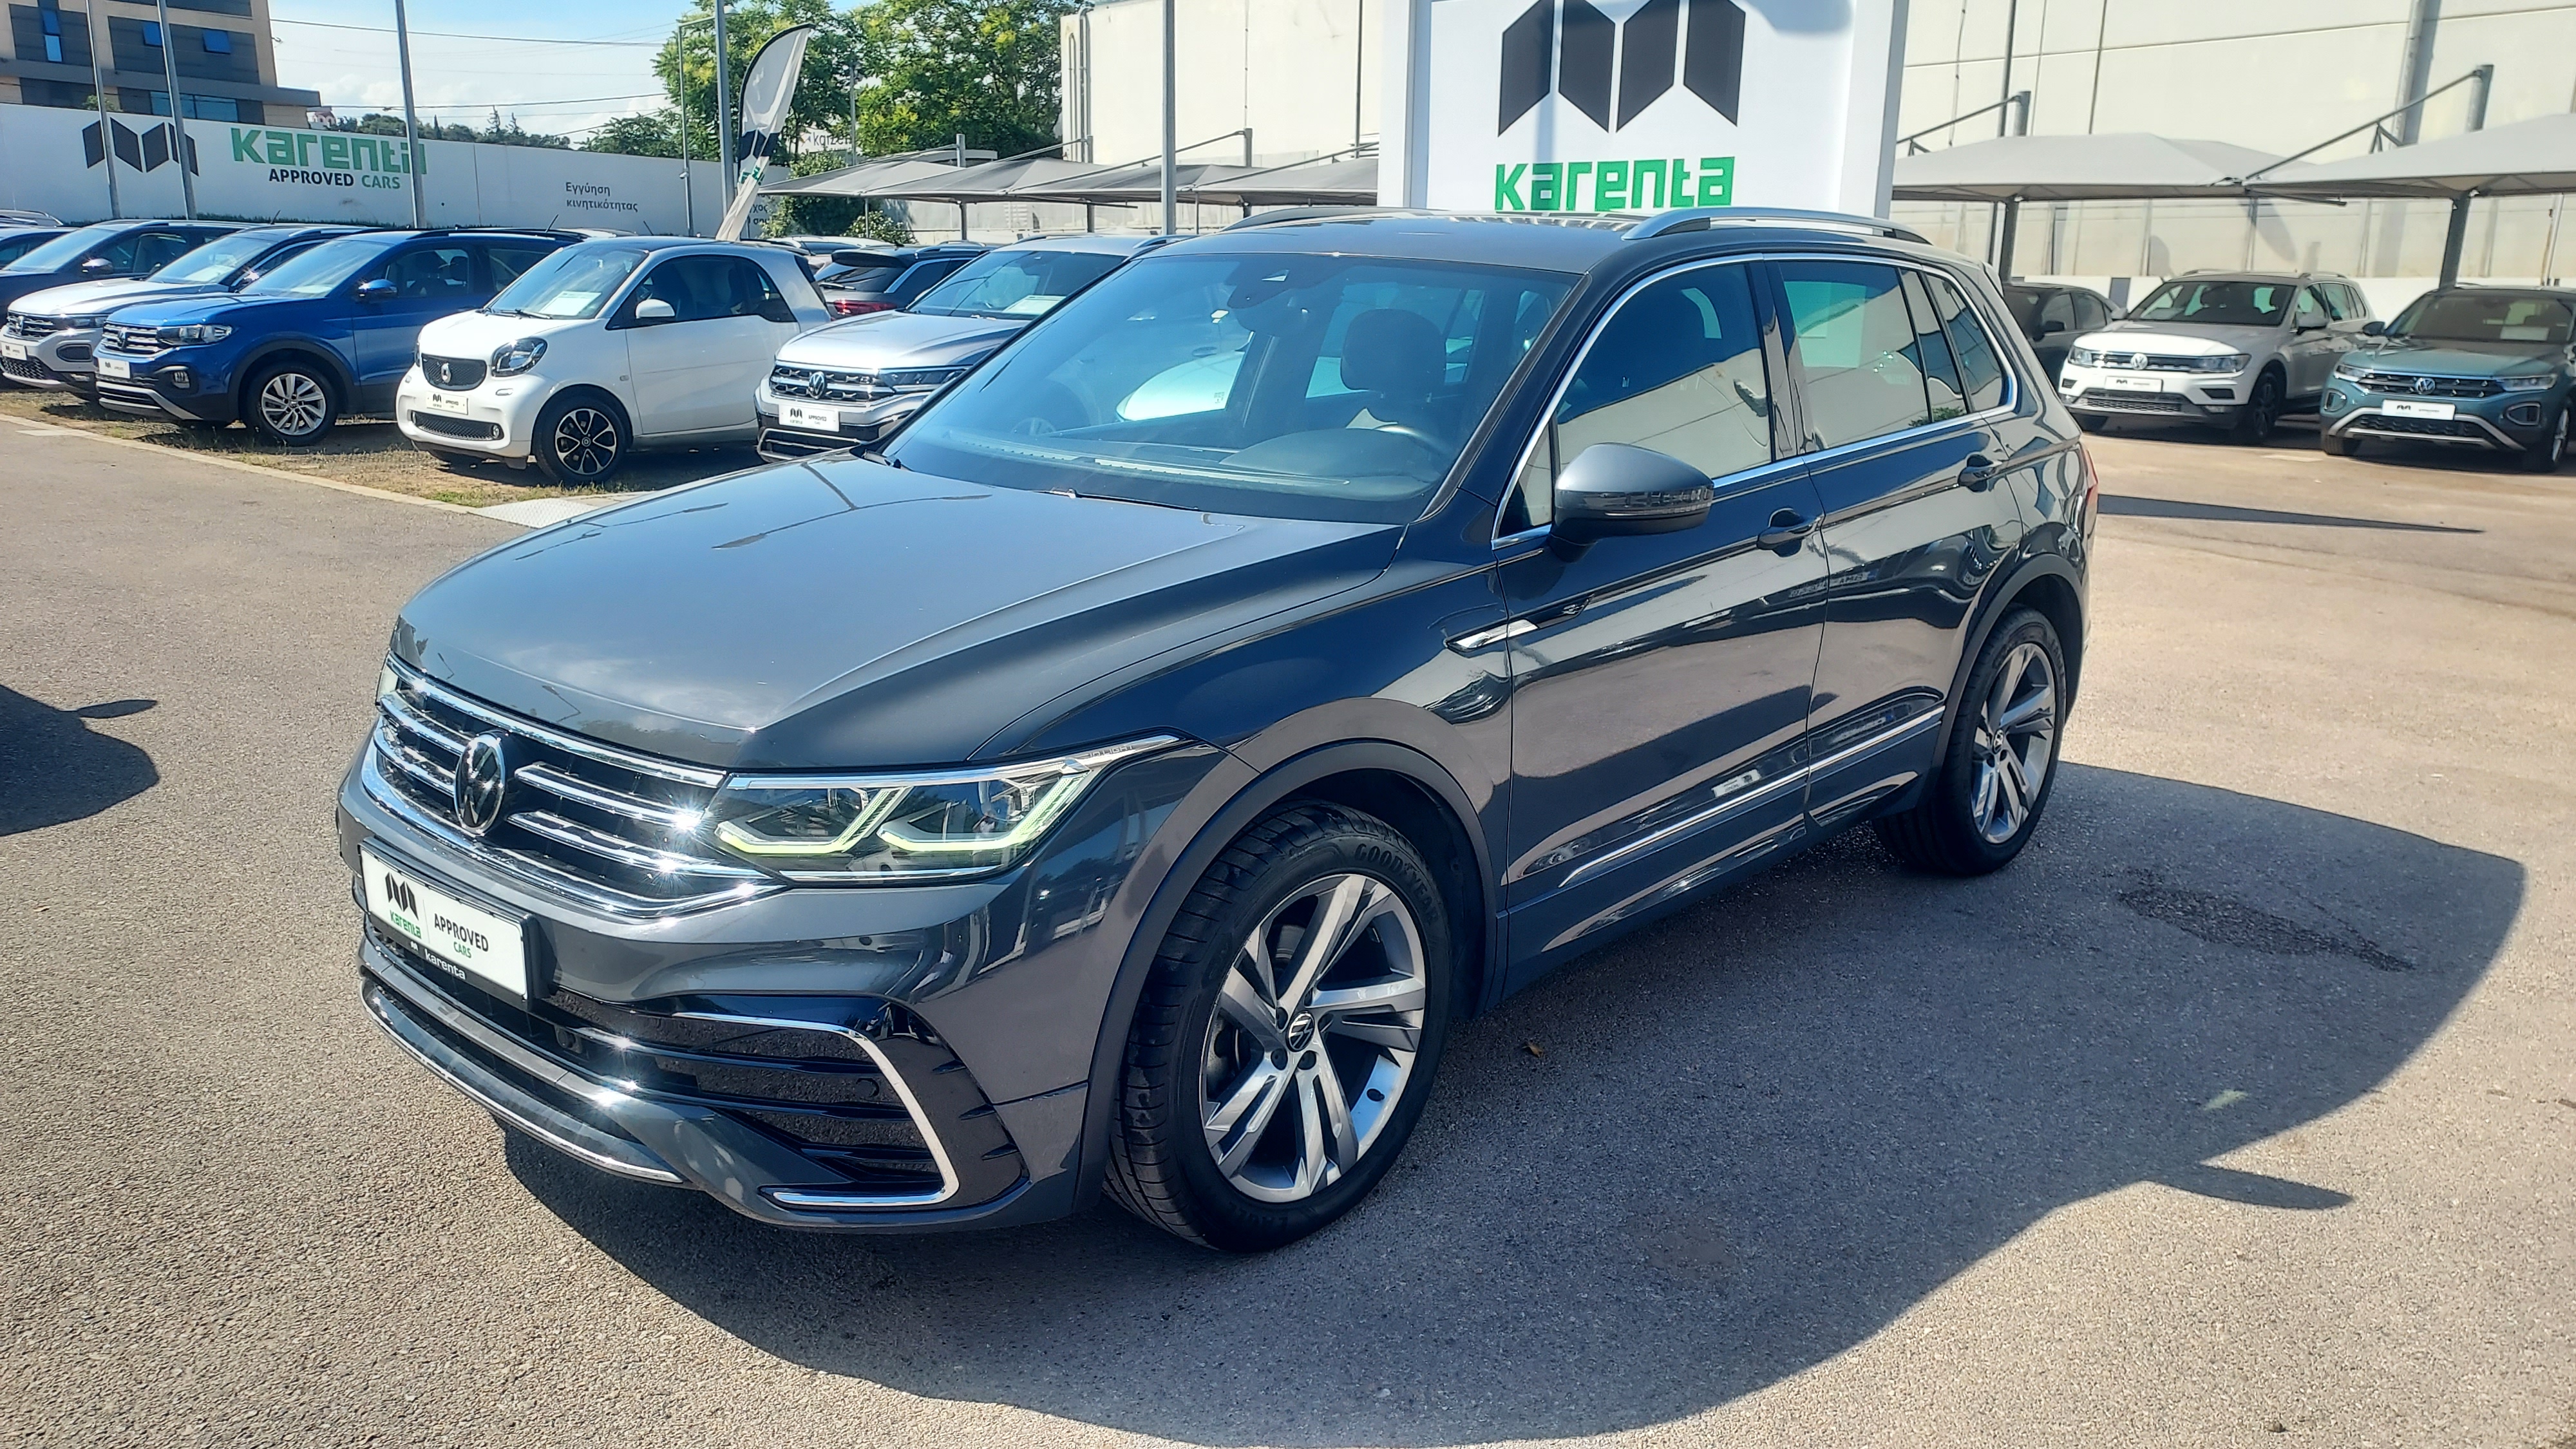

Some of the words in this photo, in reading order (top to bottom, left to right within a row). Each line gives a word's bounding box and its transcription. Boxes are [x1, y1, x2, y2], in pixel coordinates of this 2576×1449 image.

[269, 168, 354, 187] APPROVED
[361, 175, 401, 189] CARS
[565, 182, 611, 196] Εγγύηση
[567, 198, 638, 213] κινητικότητας
[434, 913, 489, 952] APPROVED
[453, 942, 472, 958] CARS
[424, 948, 466, 980] karenta
